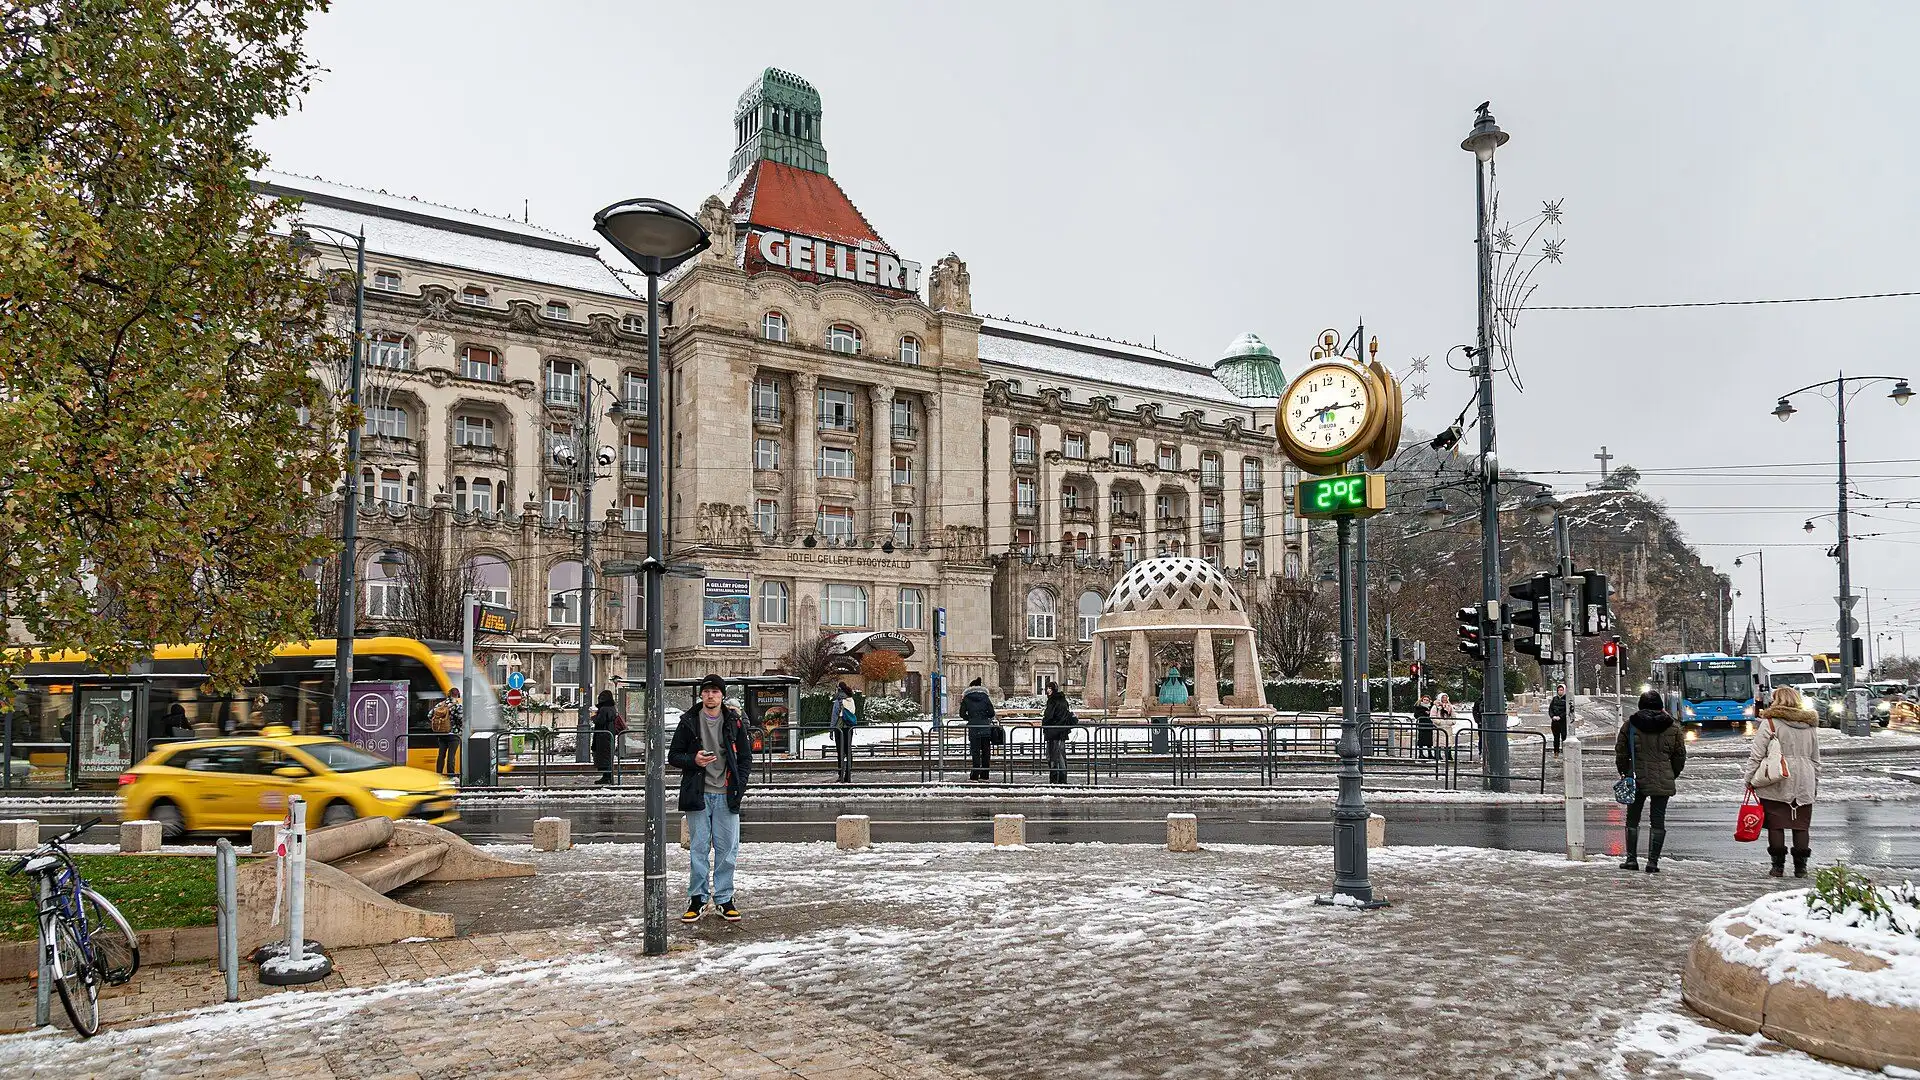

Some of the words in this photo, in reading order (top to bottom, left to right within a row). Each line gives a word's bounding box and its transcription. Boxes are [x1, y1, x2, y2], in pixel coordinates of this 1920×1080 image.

[1322, 377, 1333, 386] 12
[1341, 379, 1345, 388] 1
[1310, 383, 1317, 392] 11
[1350, 388, 1356, 397] 2
[1300, 395, 1309, 404] 10
[1295, 409, 1301, 418] 9
[1349, 416, 1354, 424] 4
[1300, 422, 1306, 431] 8
[1311, 432, 1317, 440] 7
[1339, 428, 1345, 436] 5
[1325, 433, 1331, 441] 6
[787, 553, 815, 563] HOTEL
[869, 633, 886, 642] HOTEL
